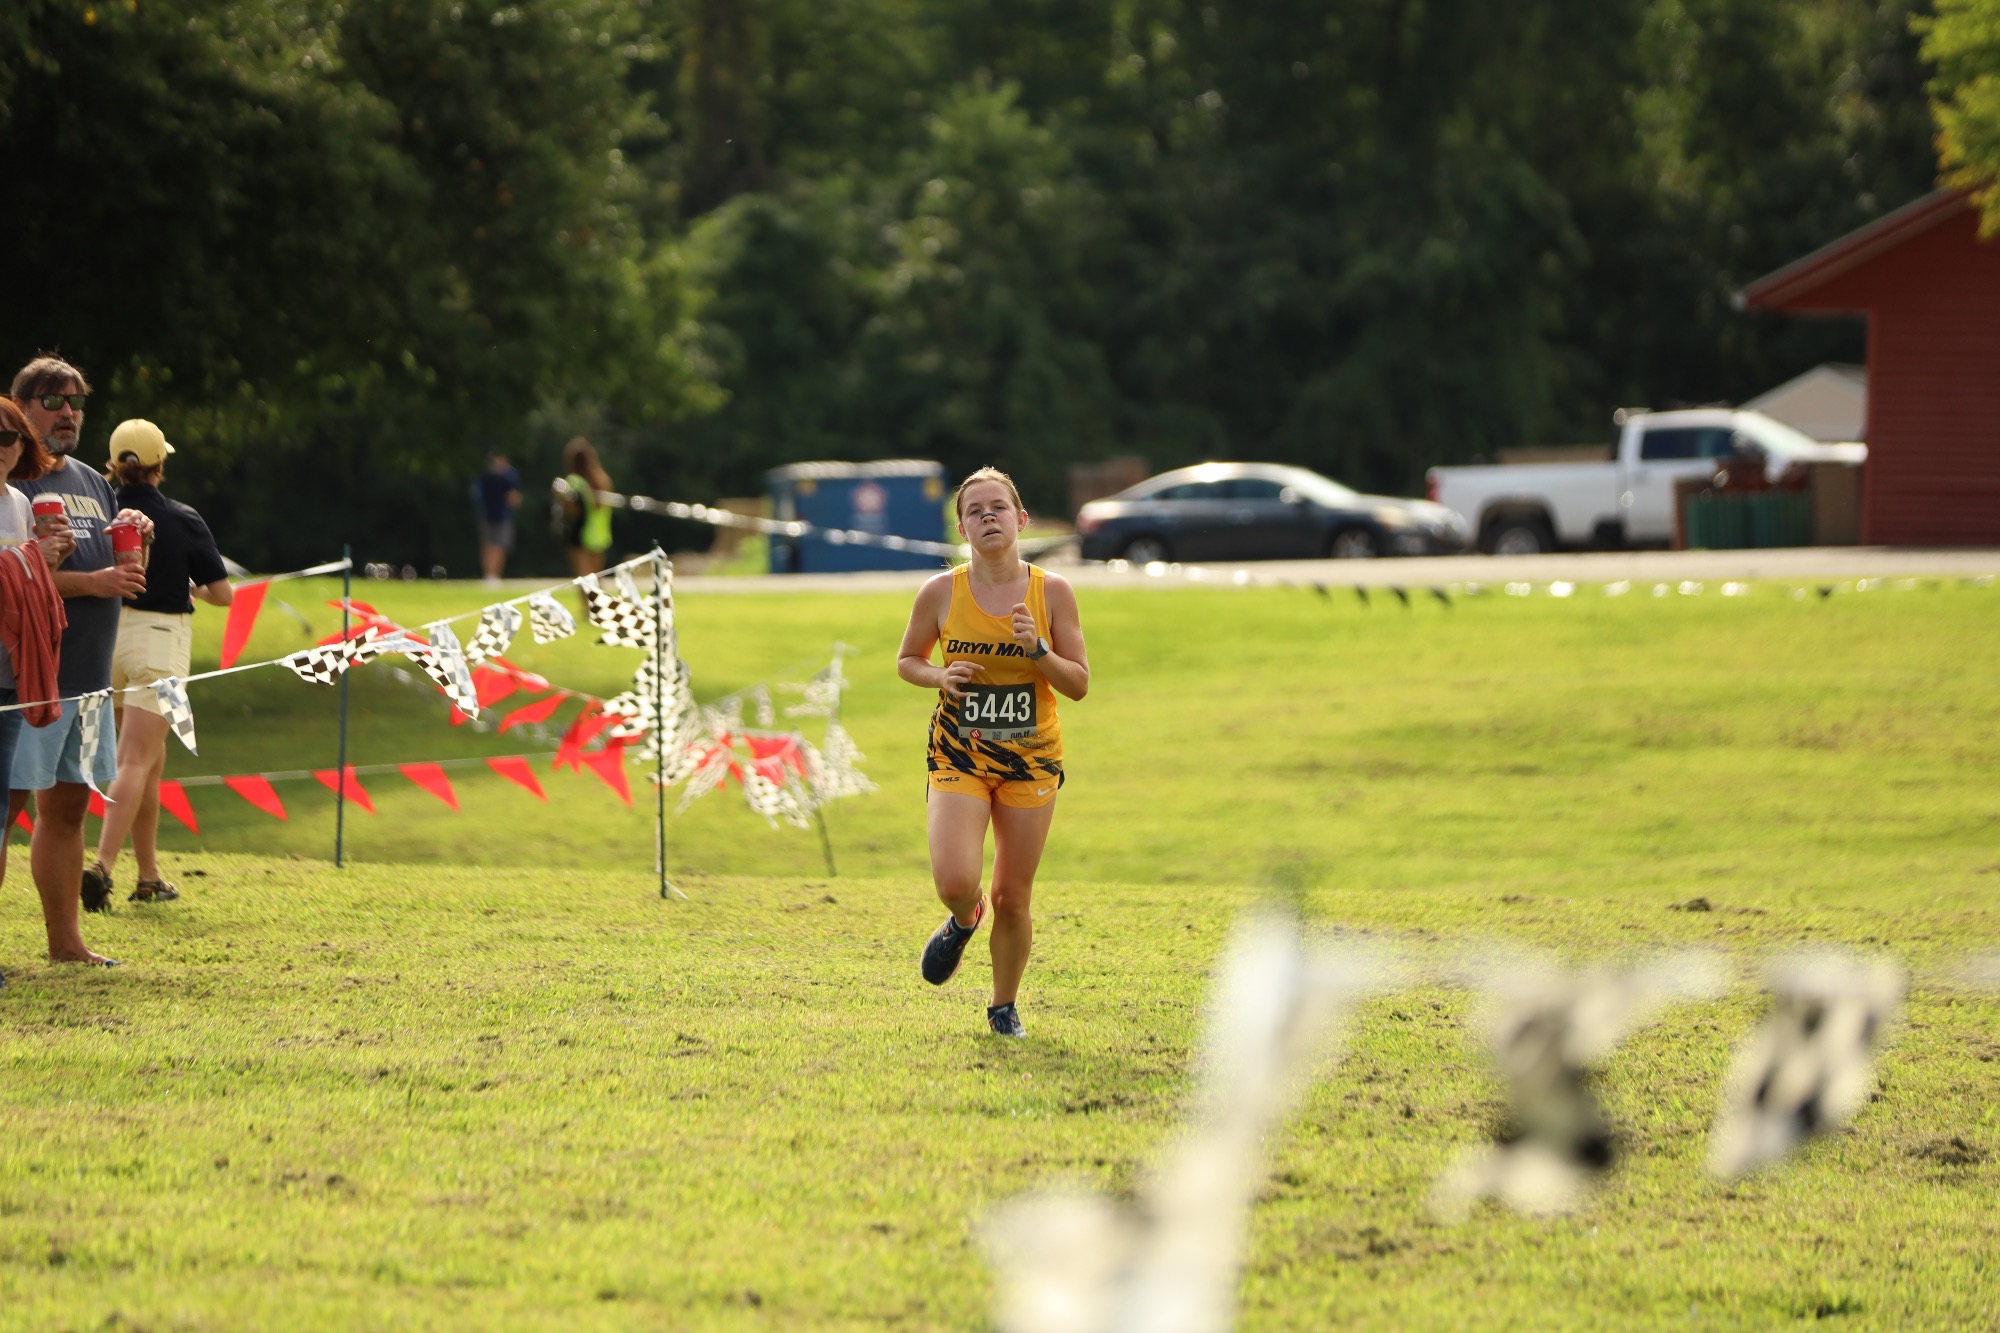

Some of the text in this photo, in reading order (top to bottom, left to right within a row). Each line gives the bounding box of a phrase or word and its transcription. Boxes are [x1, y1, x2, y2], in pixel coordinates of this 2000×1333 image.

[946, 639, 1029, 658] BRYN MA
[965, 692, 1030, 722] 5443
[1010, 729, 1030, 739] run.tf
